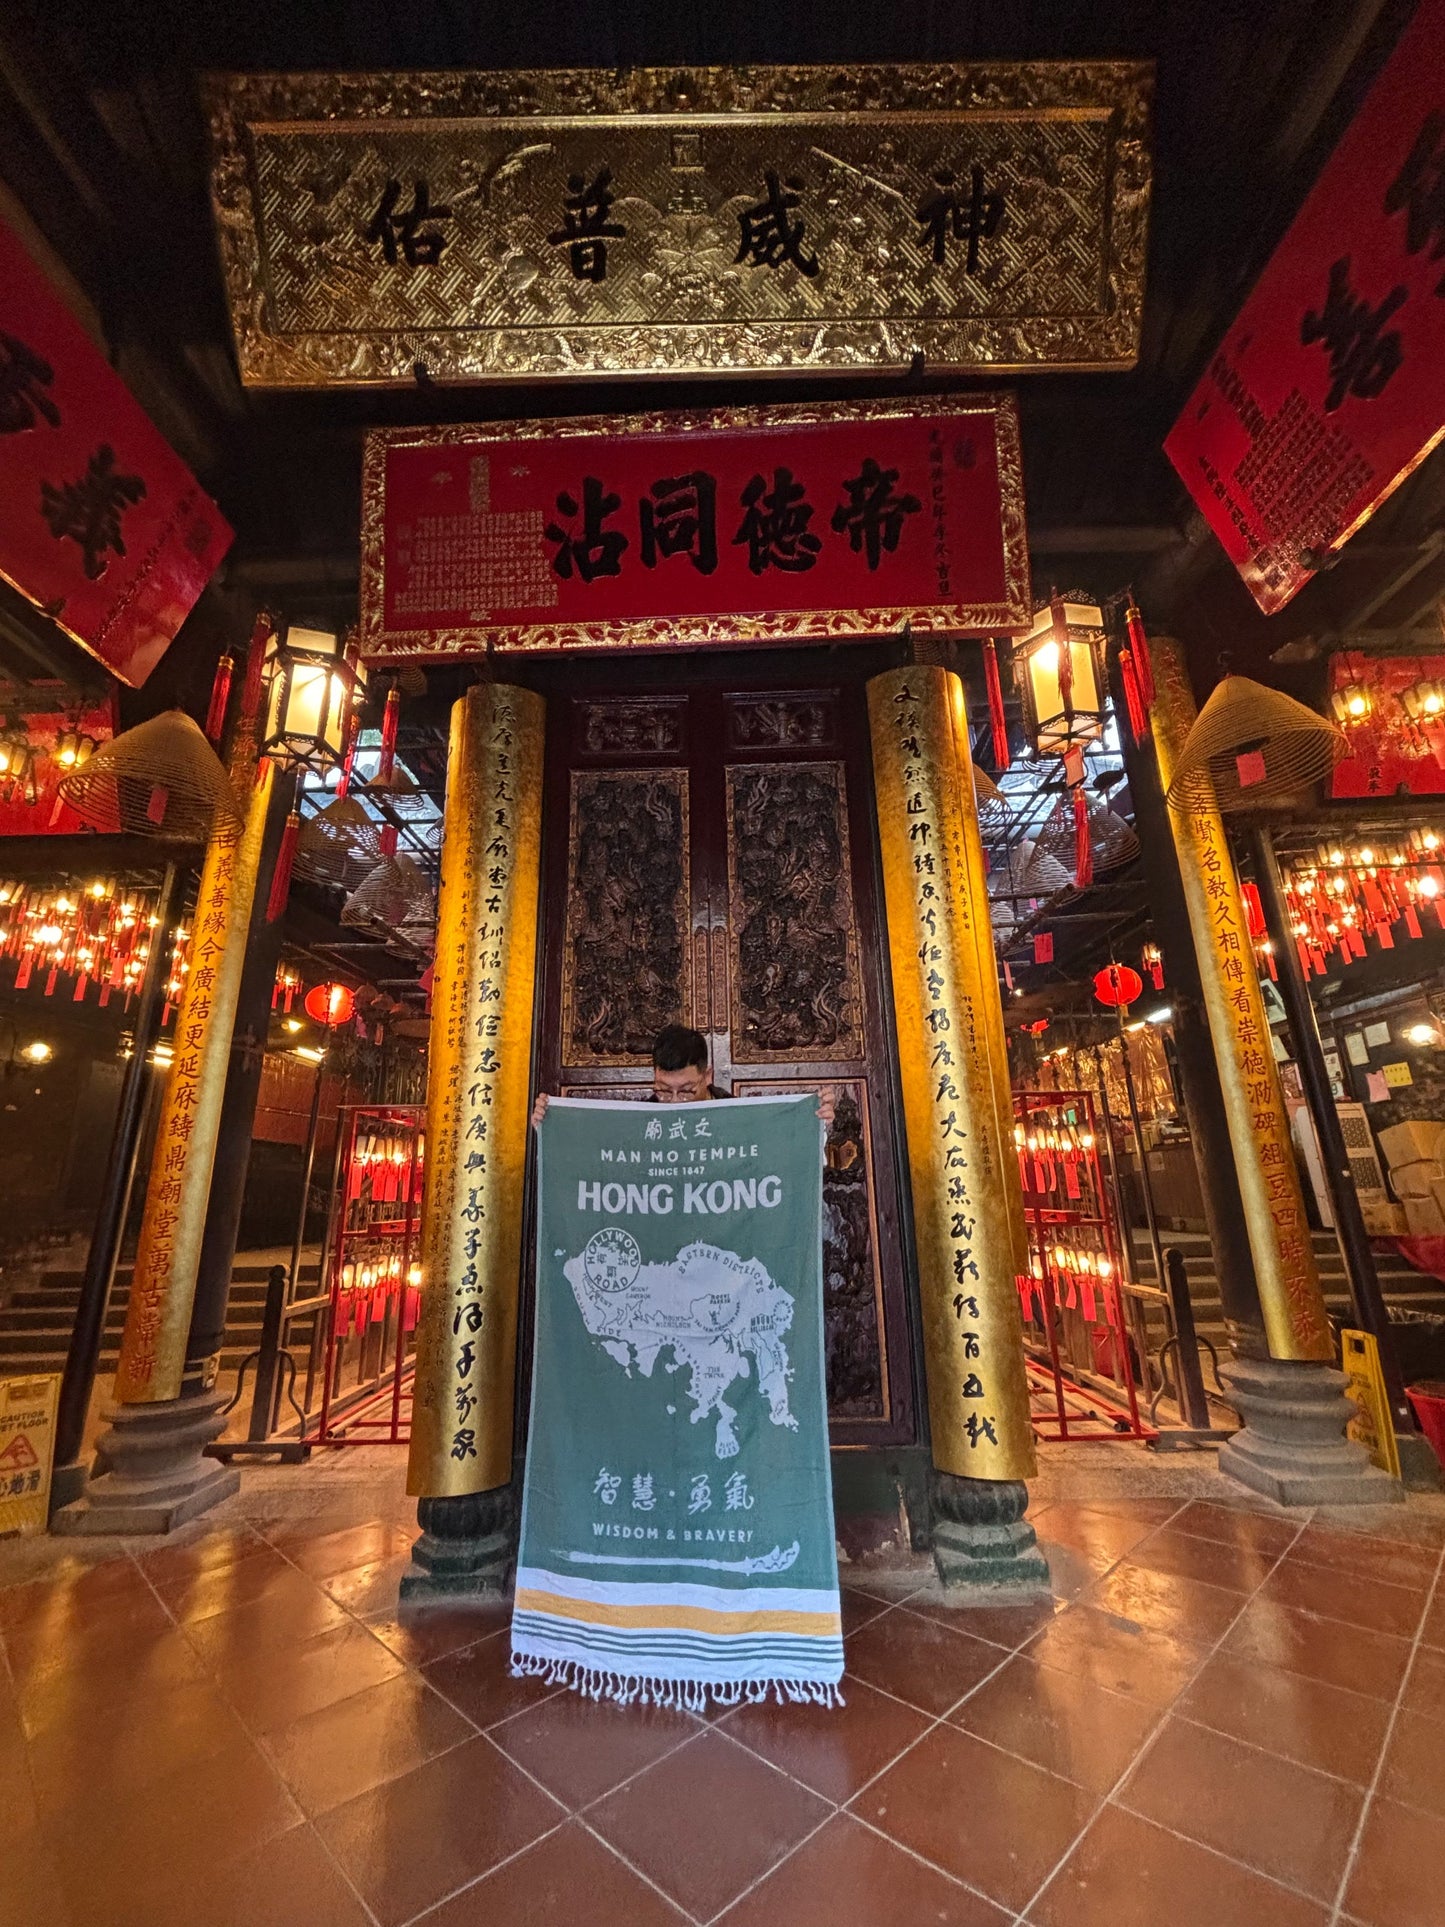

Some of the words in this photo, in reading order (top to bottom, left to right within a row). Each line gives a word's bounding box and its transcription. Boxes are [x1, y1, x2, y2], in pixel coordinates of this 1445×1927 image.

[364, 165, 1007, 283] 神威普佑
[545, 457, 923, 583] 帝德同沾
[644, 1117, 712, 1141] 文武廟
[601, 1149, 641, 1163] MAN
[651, 1150, 679, 1163] MO
[689, 1145, 759, 1162] TEMPLE
[648, 1167, 678, 1177] SINCE
[682, 1166, 705, 1176] 1847
[577, 1180, 674, 1214] HONG
[683, 1175, 782, 1214] KONG
[593, 1274, 629, 1290] ROAD
[1, 1410, 46, 1424] CAUTION
[592, 1523, 658, 1539] WISDOM
[666, 1530, 676, 1540] &
[684, 1529, 753, 1543] BRAVERY
